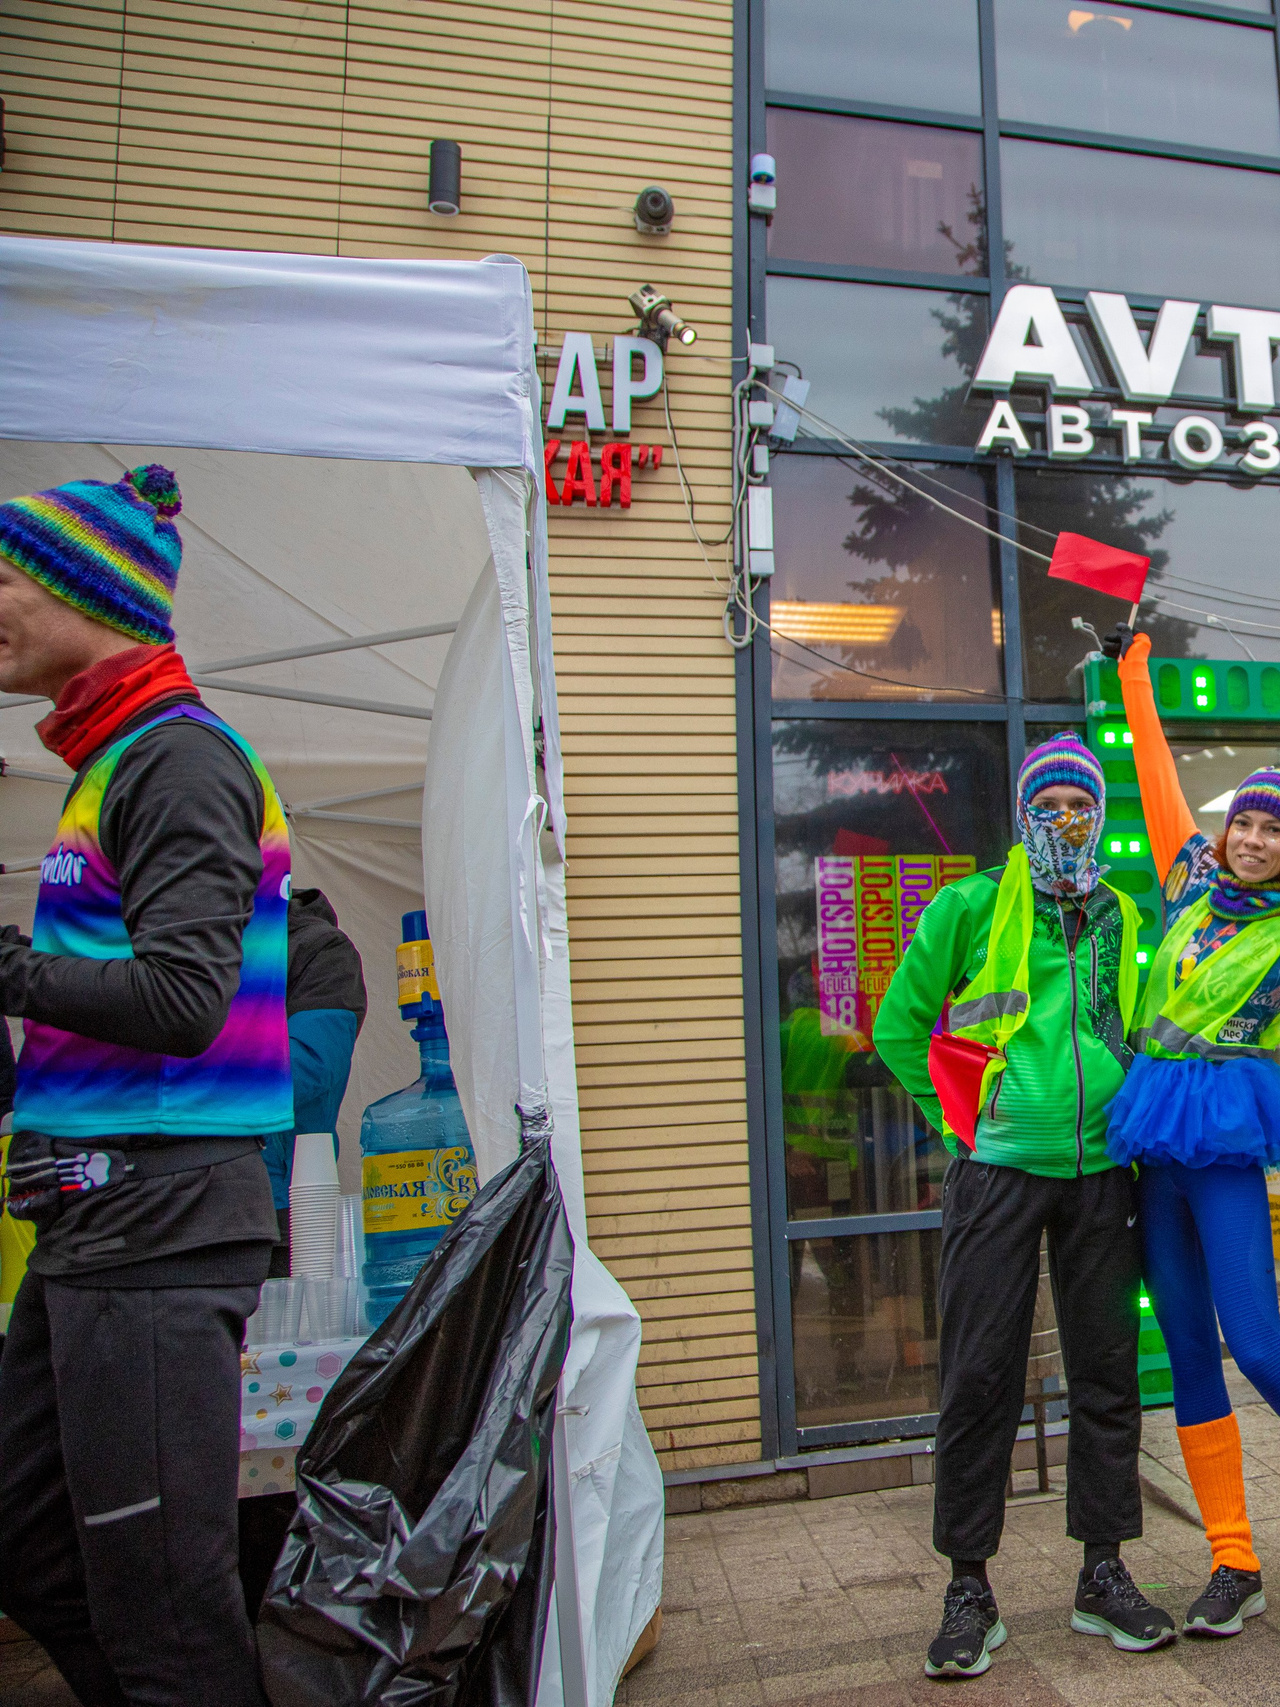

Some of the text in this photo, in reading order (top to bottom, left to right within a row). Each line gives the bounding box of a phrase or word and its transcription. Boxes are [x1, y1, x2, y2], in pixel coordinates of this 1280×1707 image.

[534, 330, 664, 437] АР
[819, 857, 857, 974] HOTSPOT
[859, 856, 896, 973] HOTSPOT
[899, 858, 933, 953] TSPOT
[826, 978, 856, 992] FUEL
[826, 996, 857, 1031] 18
